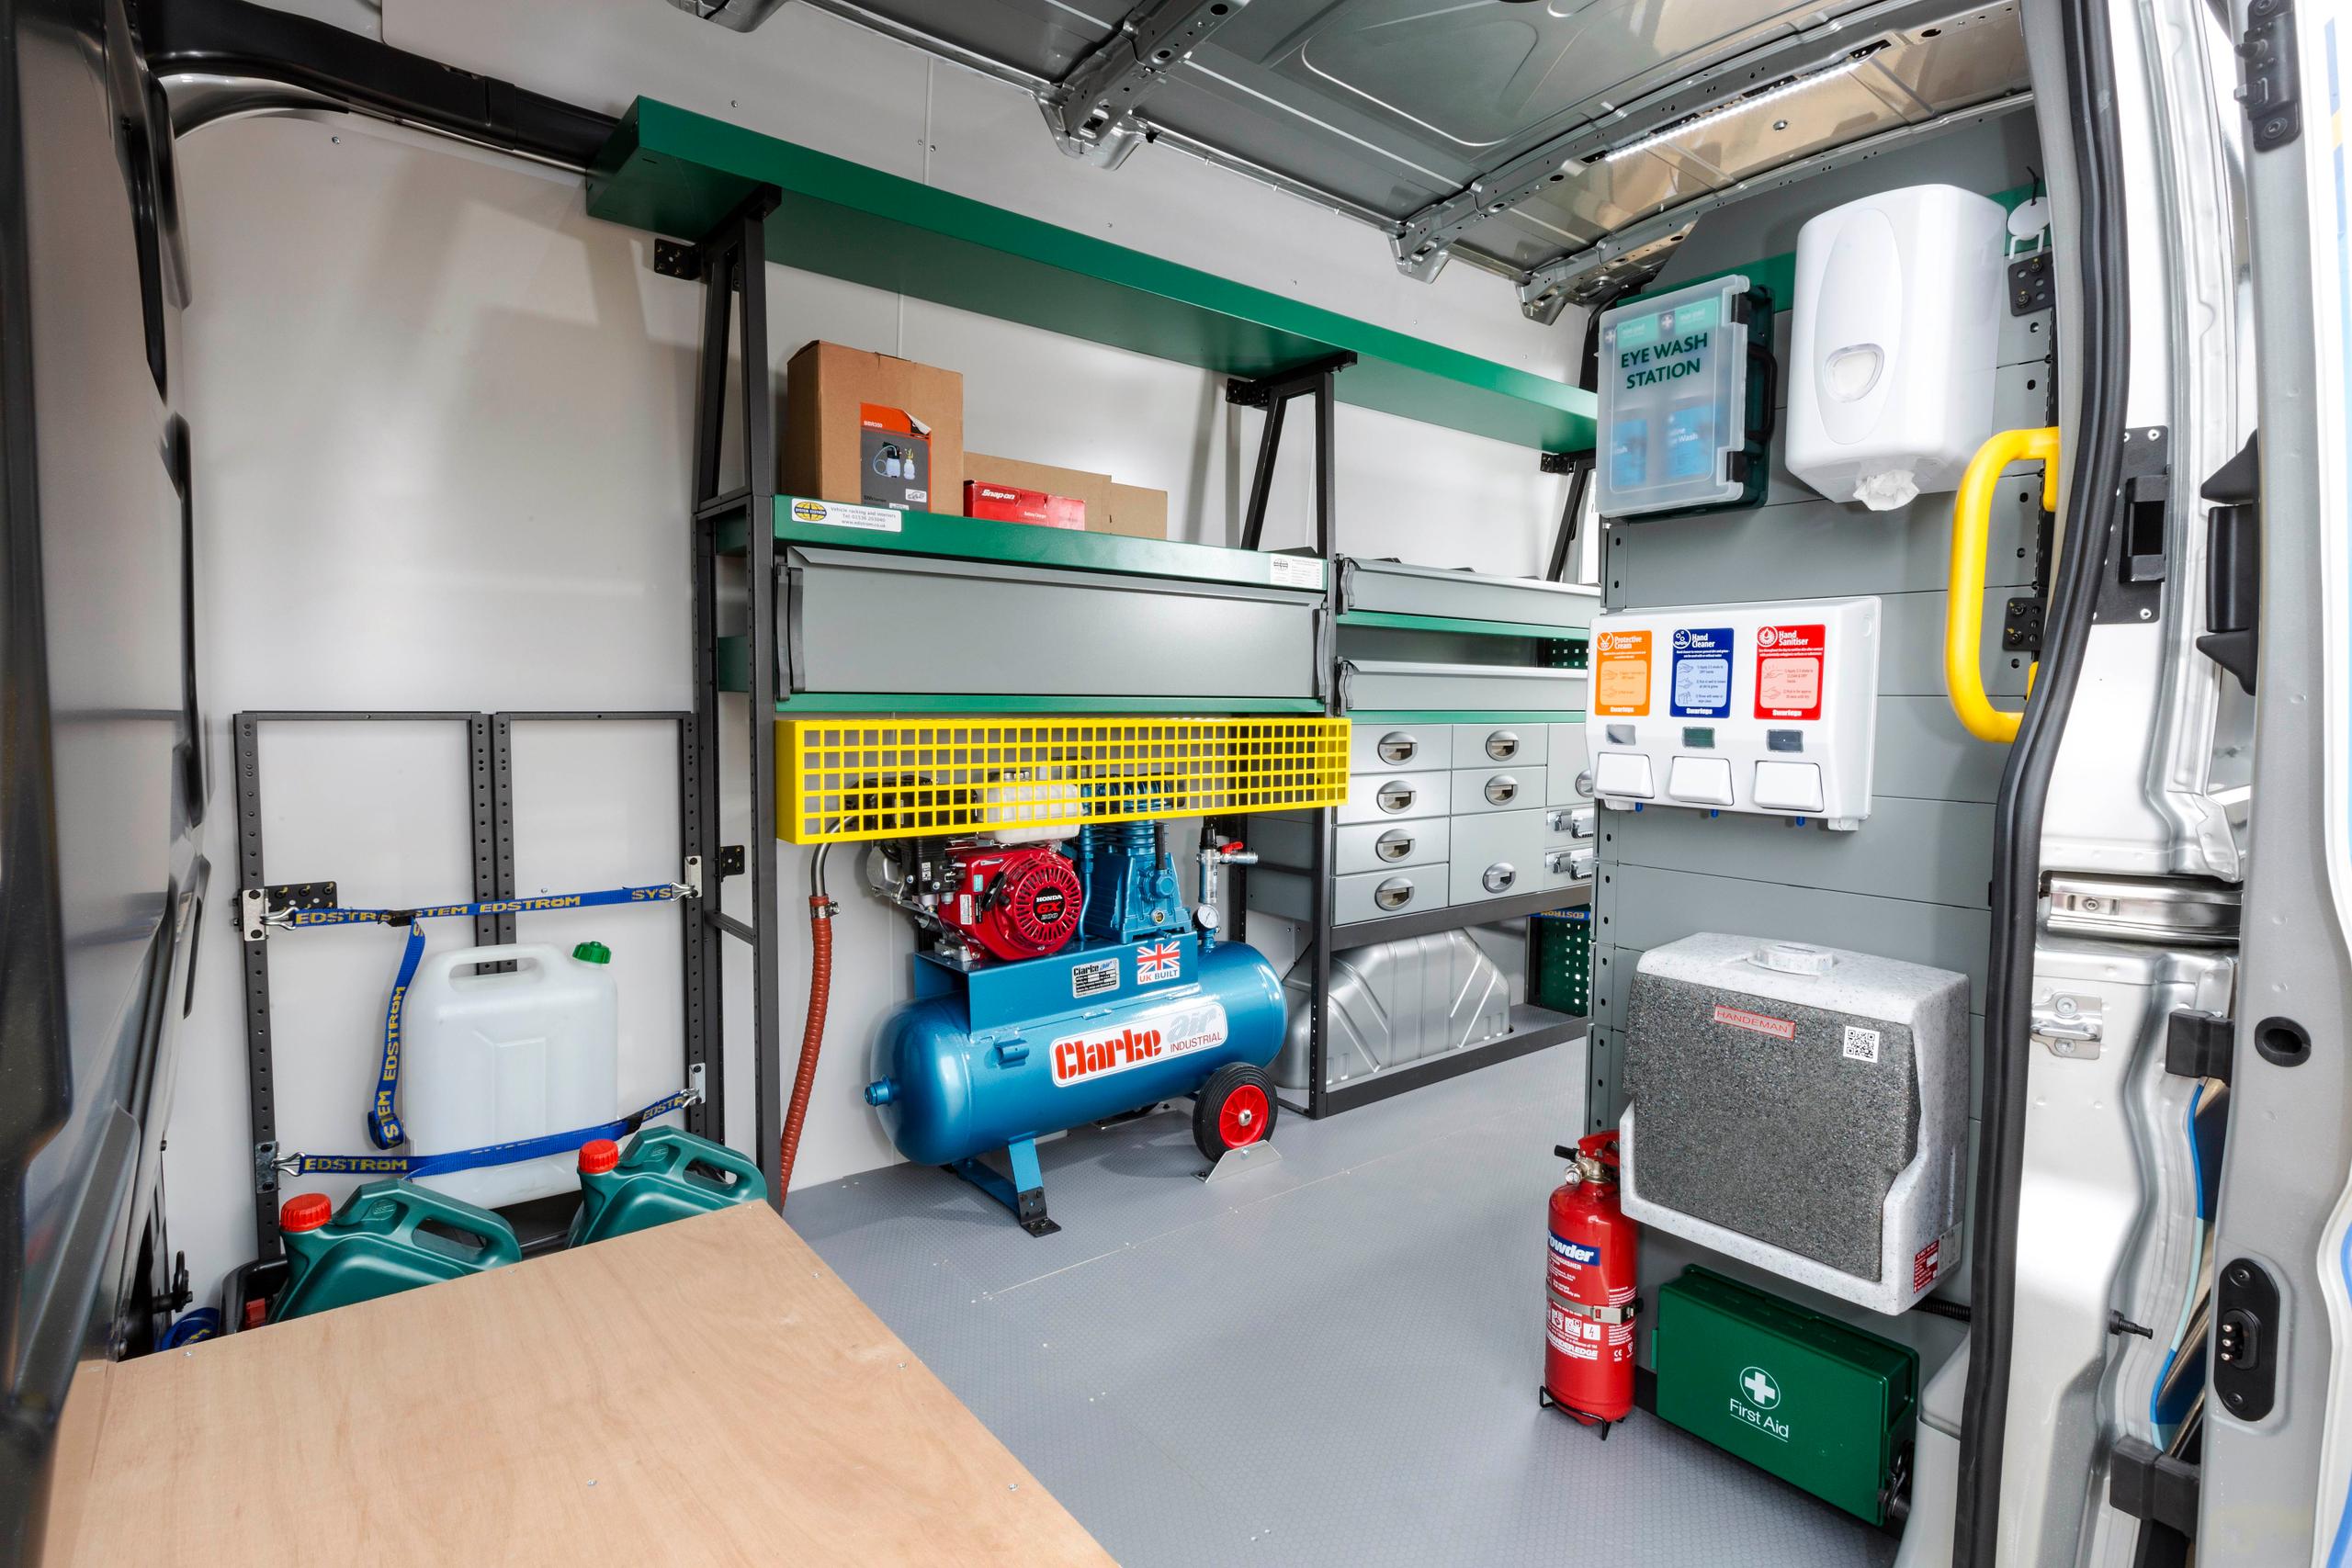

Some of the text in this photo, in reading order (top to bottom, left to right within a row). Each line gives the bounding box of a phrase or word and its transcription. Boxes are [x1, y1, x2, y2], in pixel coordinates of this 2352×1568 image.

[1621, 333, 1708, 368] EYE WASH
[1626, 357, 1701, 389] STATION
[981, 489, 1015, 500] Snap-on
[1691, 633, 1708, 641] Hand
[1779, 630, 1797, 638] Hand
[1779, 637, 1808, 646] Sanitiser
[1036, 901, 1061, 913] GX
[1073, 964, 1099, 976] Clarke
[1139, 969, 1178, 983] UK BUILT
[1716, 1009, 1790, 1034] HANDEMAN
[1054, 1008, 1217, 1080] Clarke air
[1170, 1031, 1223, 1054] INDUSTRIAL
[1730, 1397, 1790, 1438] First Aid
